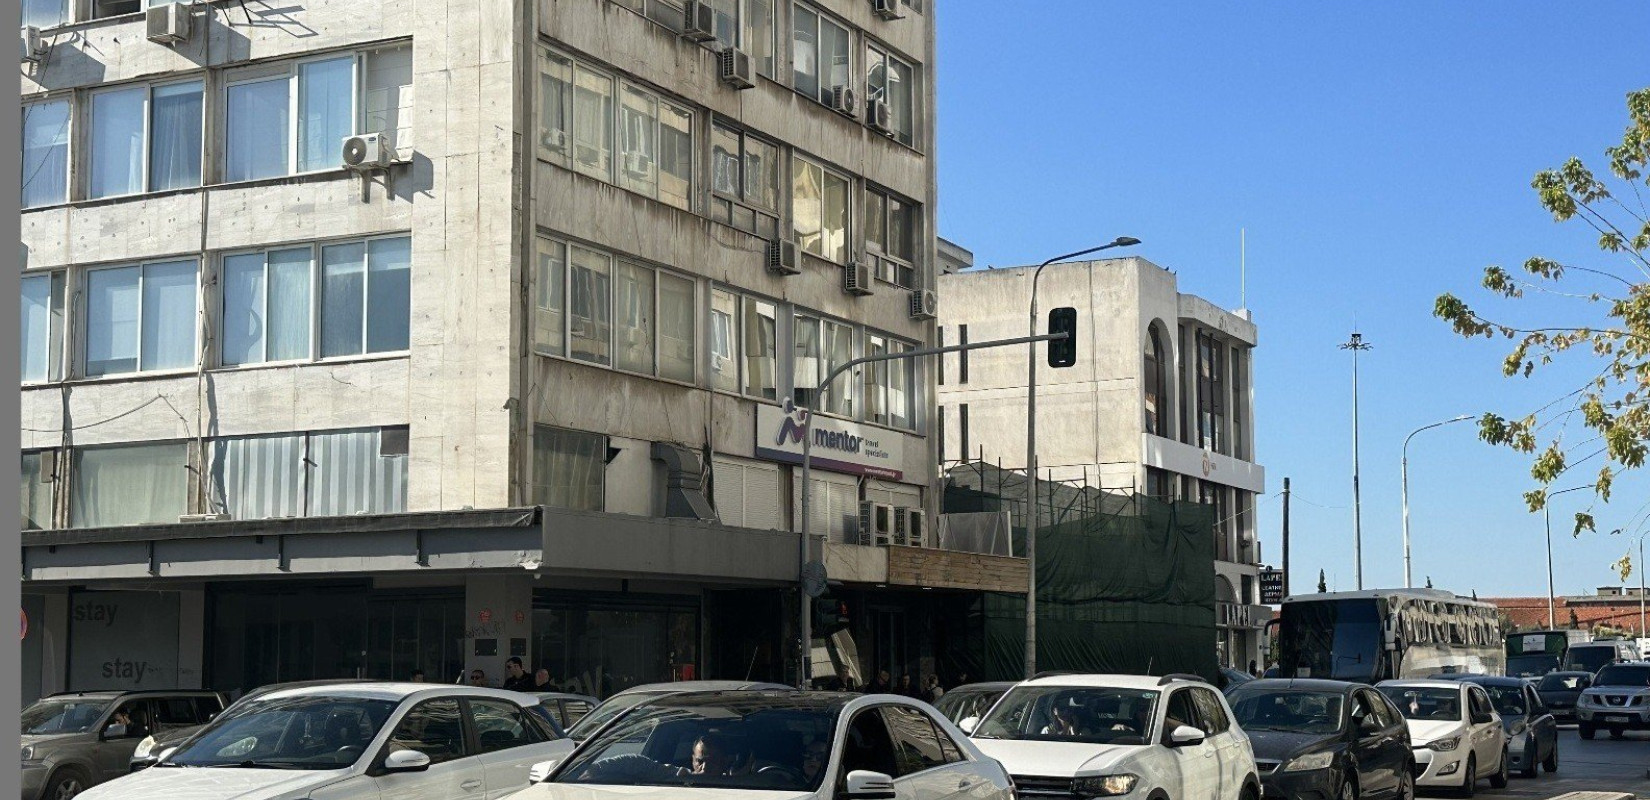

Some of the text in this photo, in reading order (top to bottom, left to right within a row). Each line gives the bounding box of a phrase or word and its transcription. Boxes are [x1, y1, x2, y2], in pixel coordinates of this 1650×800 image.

[814, 428, 864, 454] mentor
[74, 601, 118, 627] stay
[102, 656, 148, 684] stay
